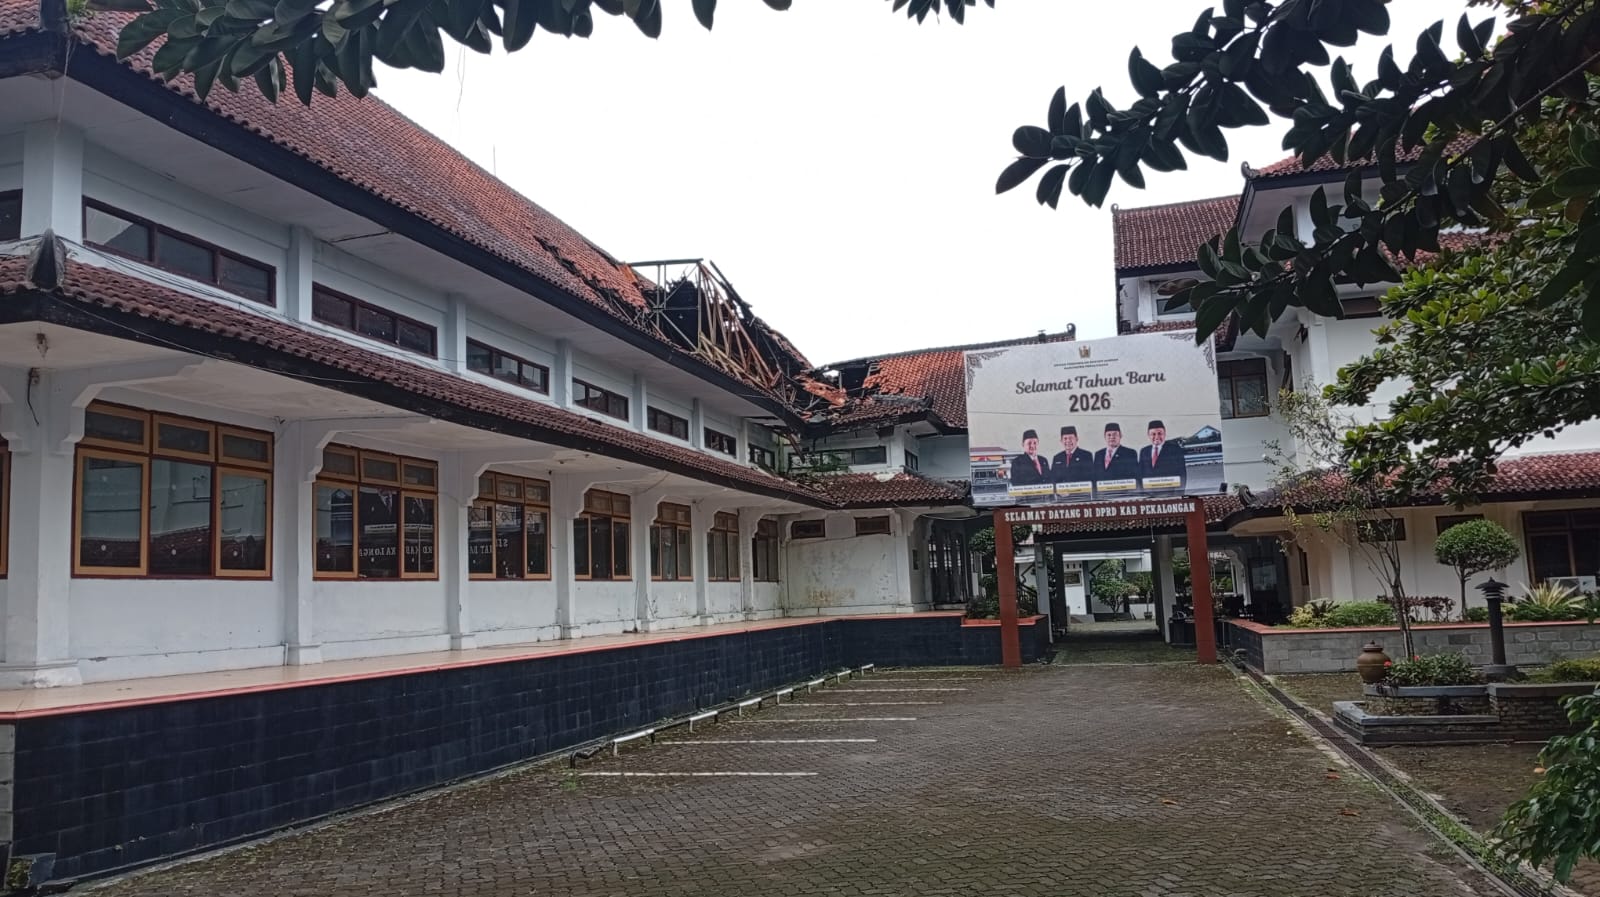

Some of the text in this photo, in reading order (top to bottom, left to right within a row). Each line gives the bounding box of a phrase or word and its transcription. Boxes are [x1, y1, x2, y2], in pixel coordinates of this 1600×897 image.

[1016, 371, 1166, 394] Selamat Tahun Baru
[1069, 392, 1111, 412] 2026
[1005, 502, 1195, 521] SELAMAT DATANG DI DPRD KAB PEKALONGAN
